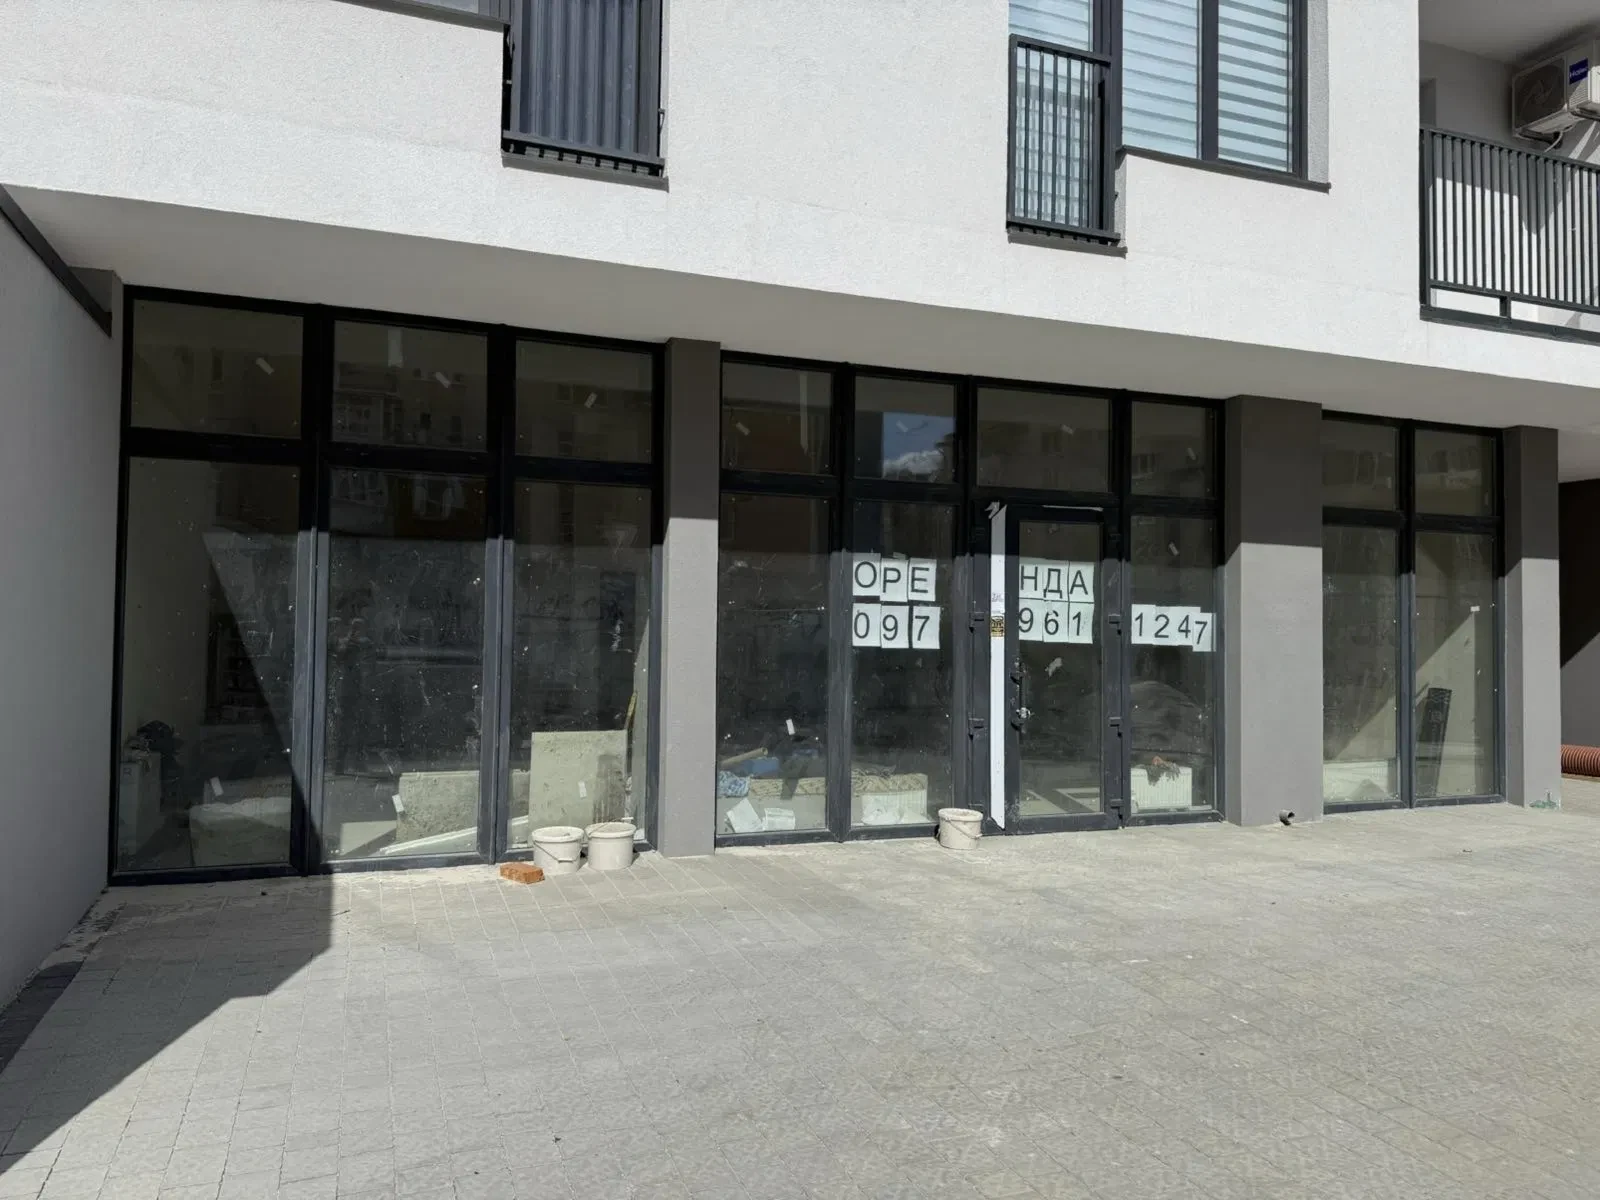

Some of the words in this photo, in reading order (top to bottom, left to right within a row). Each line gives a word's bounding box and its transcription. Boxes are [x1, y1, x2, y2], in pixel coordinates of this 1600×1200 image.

[855, 561, 930, 593] ОРЕ
[1020, 565, 1088, 599] НДА
[854, 612, 930, 641] 097
[1019, 607, 1081, 636] 961
[1135, 612, 1208, 645] 1247
